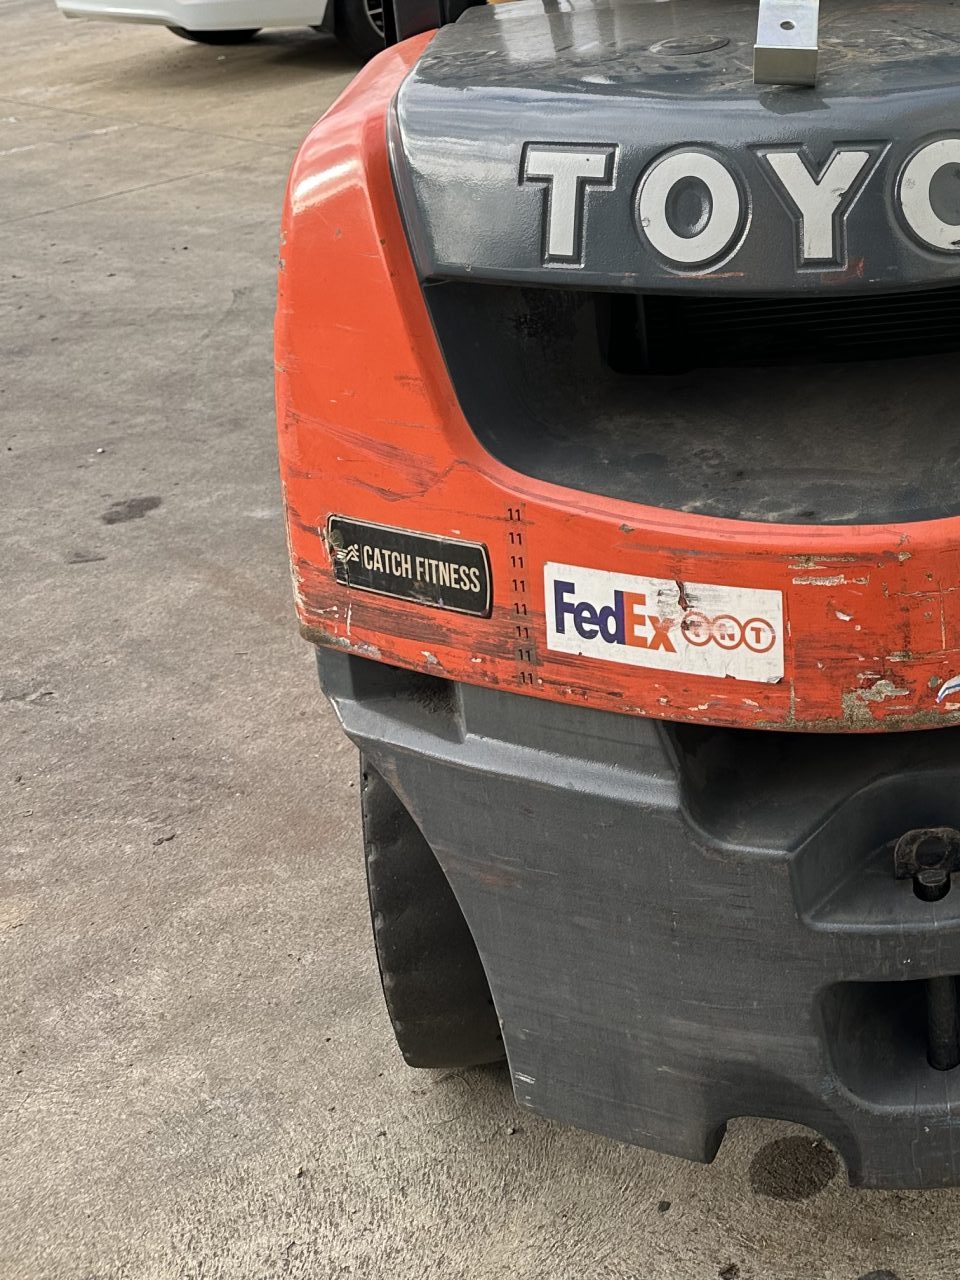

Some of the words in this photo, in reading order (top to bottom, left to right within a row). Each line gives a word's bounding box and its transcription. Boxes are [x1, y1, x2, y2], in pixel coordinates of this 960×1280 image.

[363, 545, 412, 579] CATCH
[415, 556, 481, 593] FITNESS
[553, 579, 677, 654] FedEx
